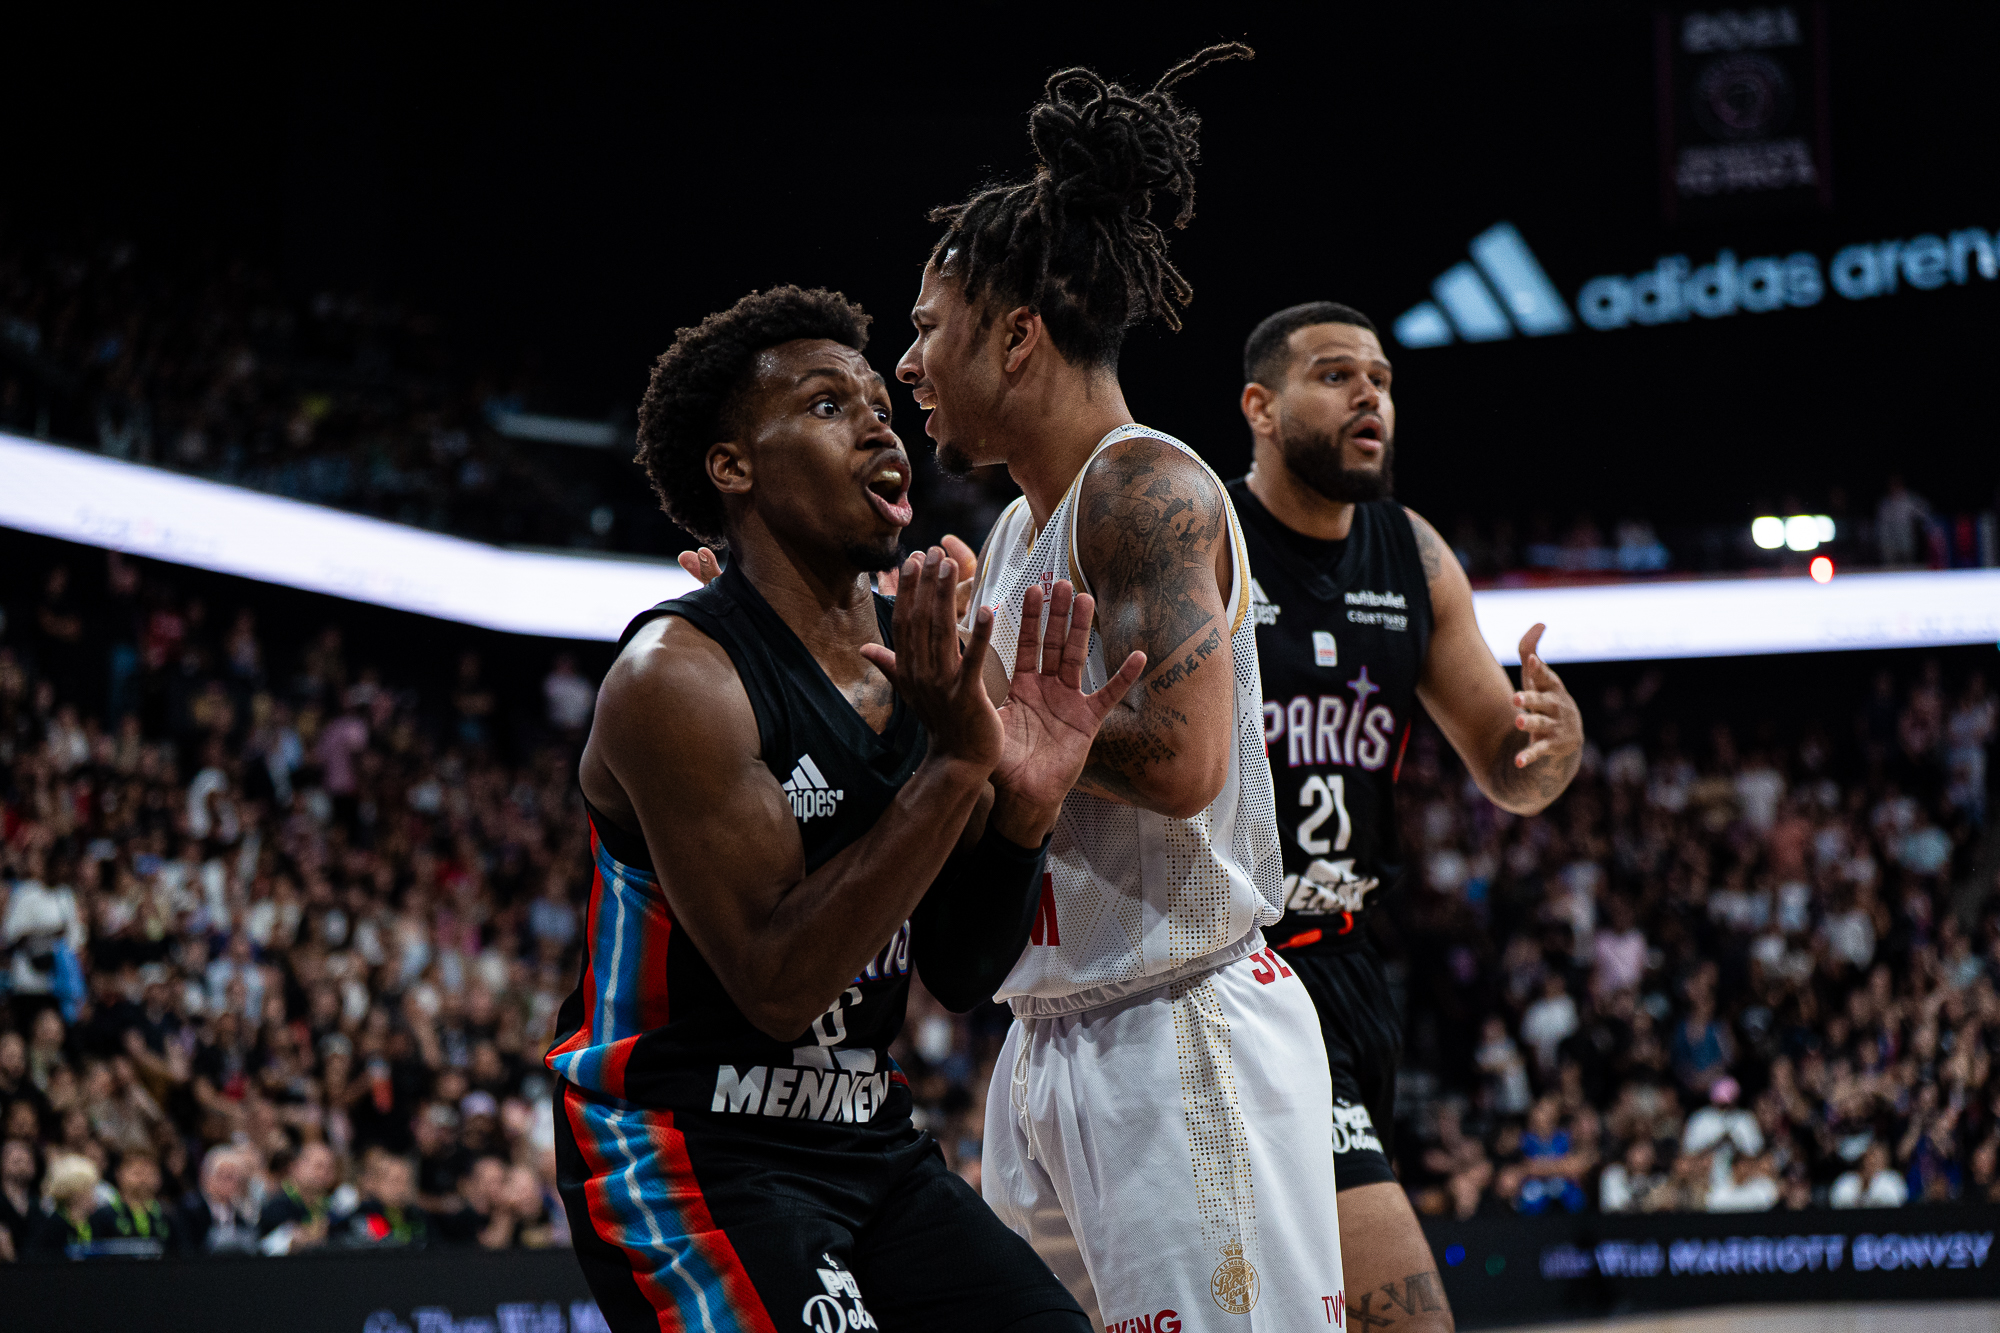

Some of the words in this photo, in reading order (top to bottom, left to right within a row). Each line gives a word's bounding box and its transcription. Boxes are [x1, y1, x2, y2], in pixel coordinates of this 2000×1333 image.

[1577, 248, 1824, 330] adidas
[1830, 226, 2000, 298] aren
[1194, 626, 1222, 660] FIRST
[1263, 692, 1396, 771] PARIS
[787, 789, 836, 823] nipes
[1297, 774, 1352, 855] 21
[711, 1064, 889, 1123] MENNEN
[1853, 1231, 1994, 1271] BONVOY
